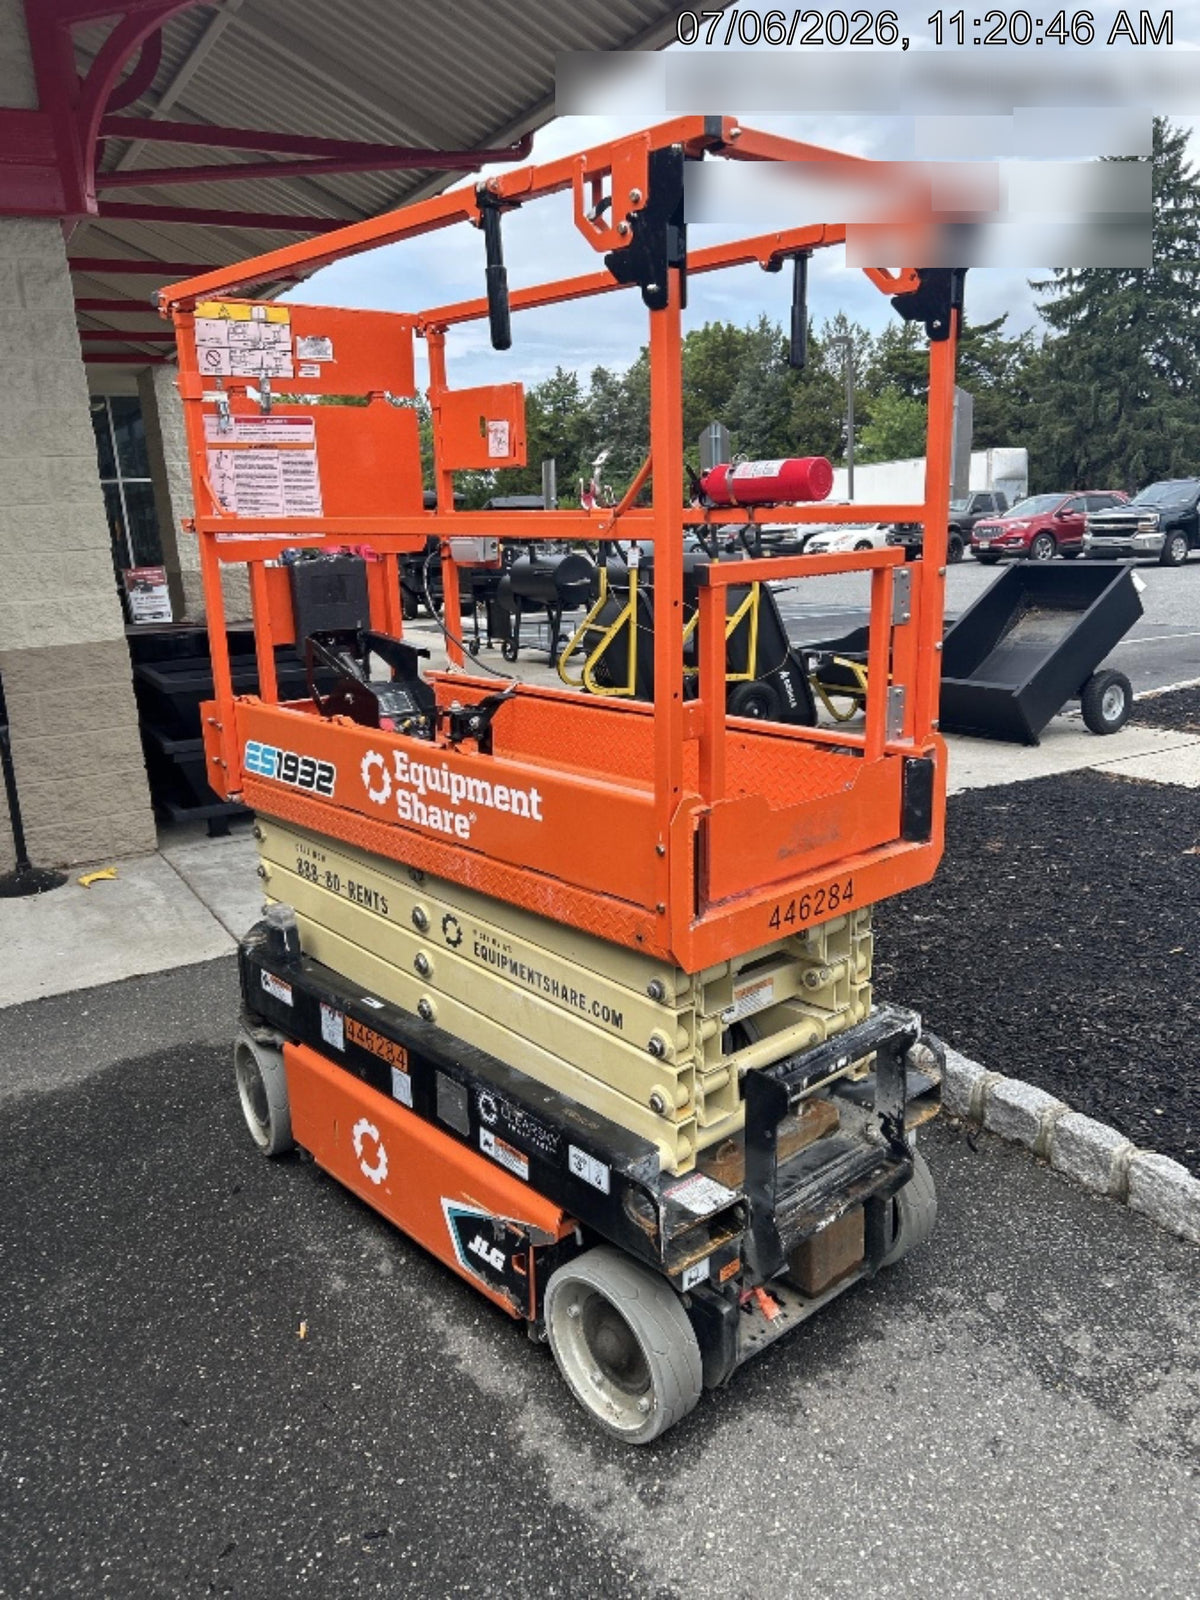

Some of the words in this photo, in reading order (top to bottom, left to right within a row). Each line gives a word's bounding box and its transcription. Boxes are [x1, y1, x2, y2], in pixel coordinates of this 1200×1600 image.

[245, 742, 336, 796] ES1932
[392, 750, 543, 822] Equipment
[768, 878, 854, 931] 446284
[473, 941, 624, 1031] EQUIPMENTSHARE.COM
[346, 1020, 406, 1069] 446284
[467, 1234, 506, 1272] JLG
